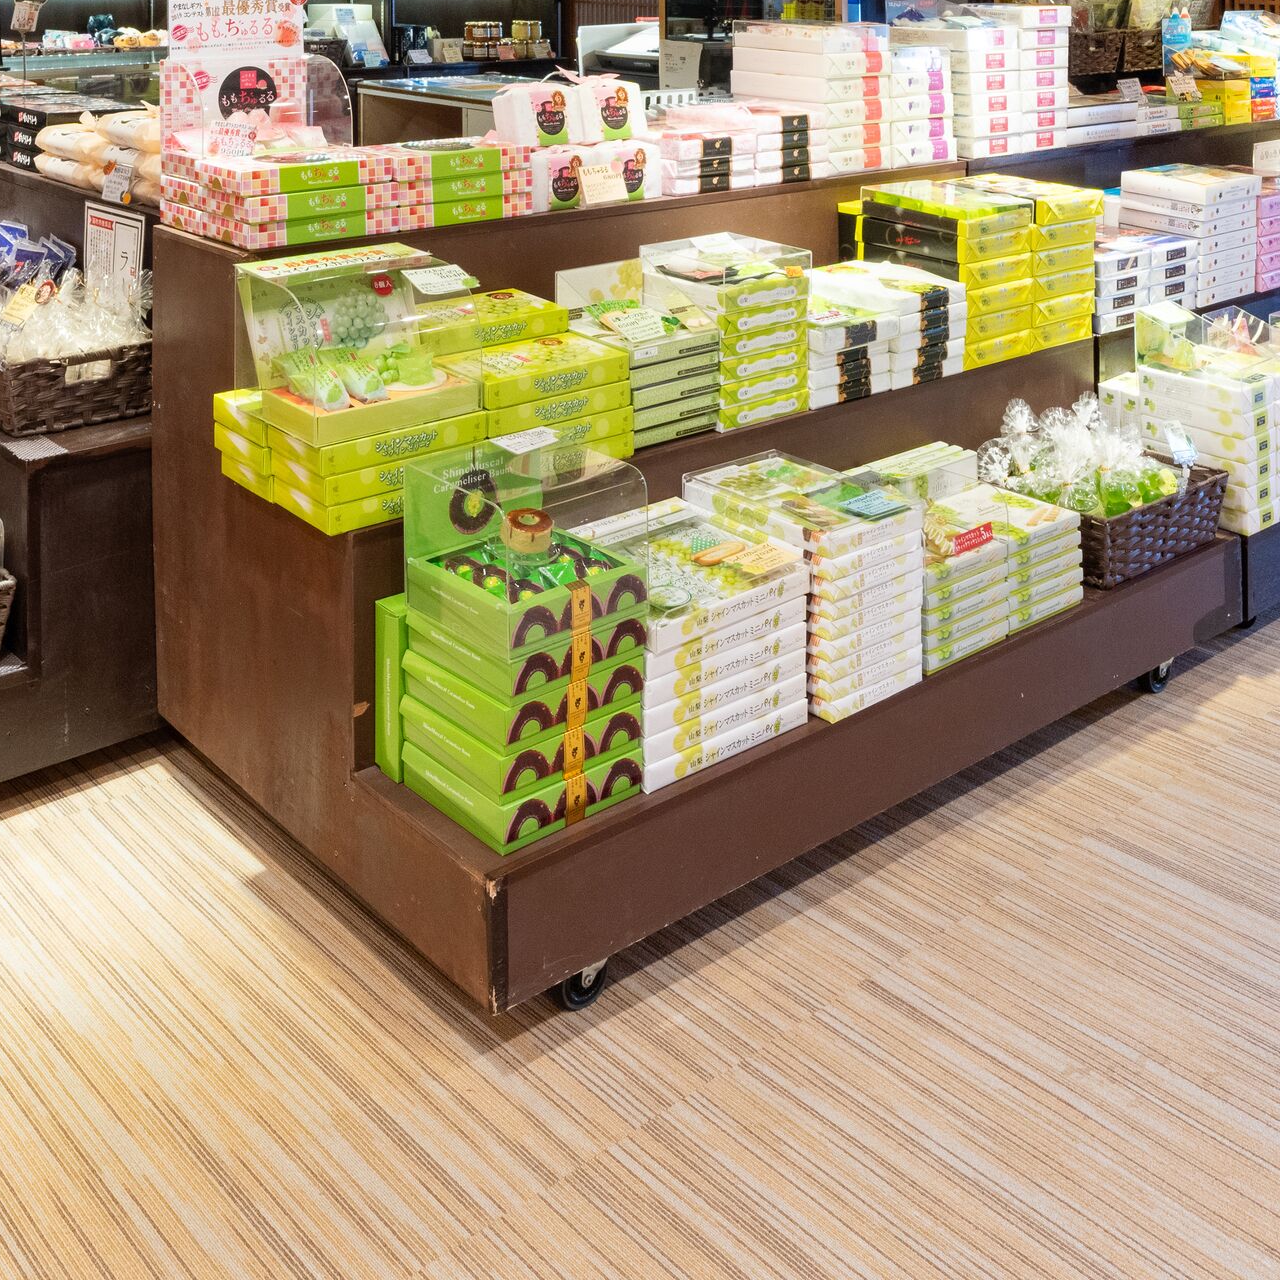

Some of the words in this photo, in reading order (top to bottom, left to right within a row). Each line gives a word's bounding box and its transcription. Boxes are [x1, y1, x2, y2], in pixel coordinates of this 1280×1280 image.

[173, 2, 203, 10] やまなしギフト
[222, 90, 275, 107] ももちゅるる
[534, 370, 588, 389] シャインマスカット
[534, 396, 589, 416] シャインマスカット
[375, 430, 438, 452] シャインマスカット
[696, 614, 709, 627] 山梨
[711, 595, 754, 621] シャインマスカット
[754, 586, 778, 604] ミニパイ
[689, 645, 702, 658] 山梨
[704, 628, 749, 654] シャインマスカット
[749, 617, 773, 635] ミニパイ
[689, 672, 702, 686] 山梨
[704, 655, 749, 681] シャインマスカット
[749, 645, 772, 662] ミニパイ
[688, 699, 701, 713] 山梨
[703, 683, 748, 708] シャインマスカット
[749, 672, 772, 689] ミニパイ
[688, 727, 701, 740] 山梨
[703, 710, 748, 735] シャインマスカット
[749, 697, 772, 715] ミニパイ
[690, 755, 703, 768] 山梨
[705, 738, 750, 762] シャインマスカット
[750, 723, 774, 741] ミニパイ
